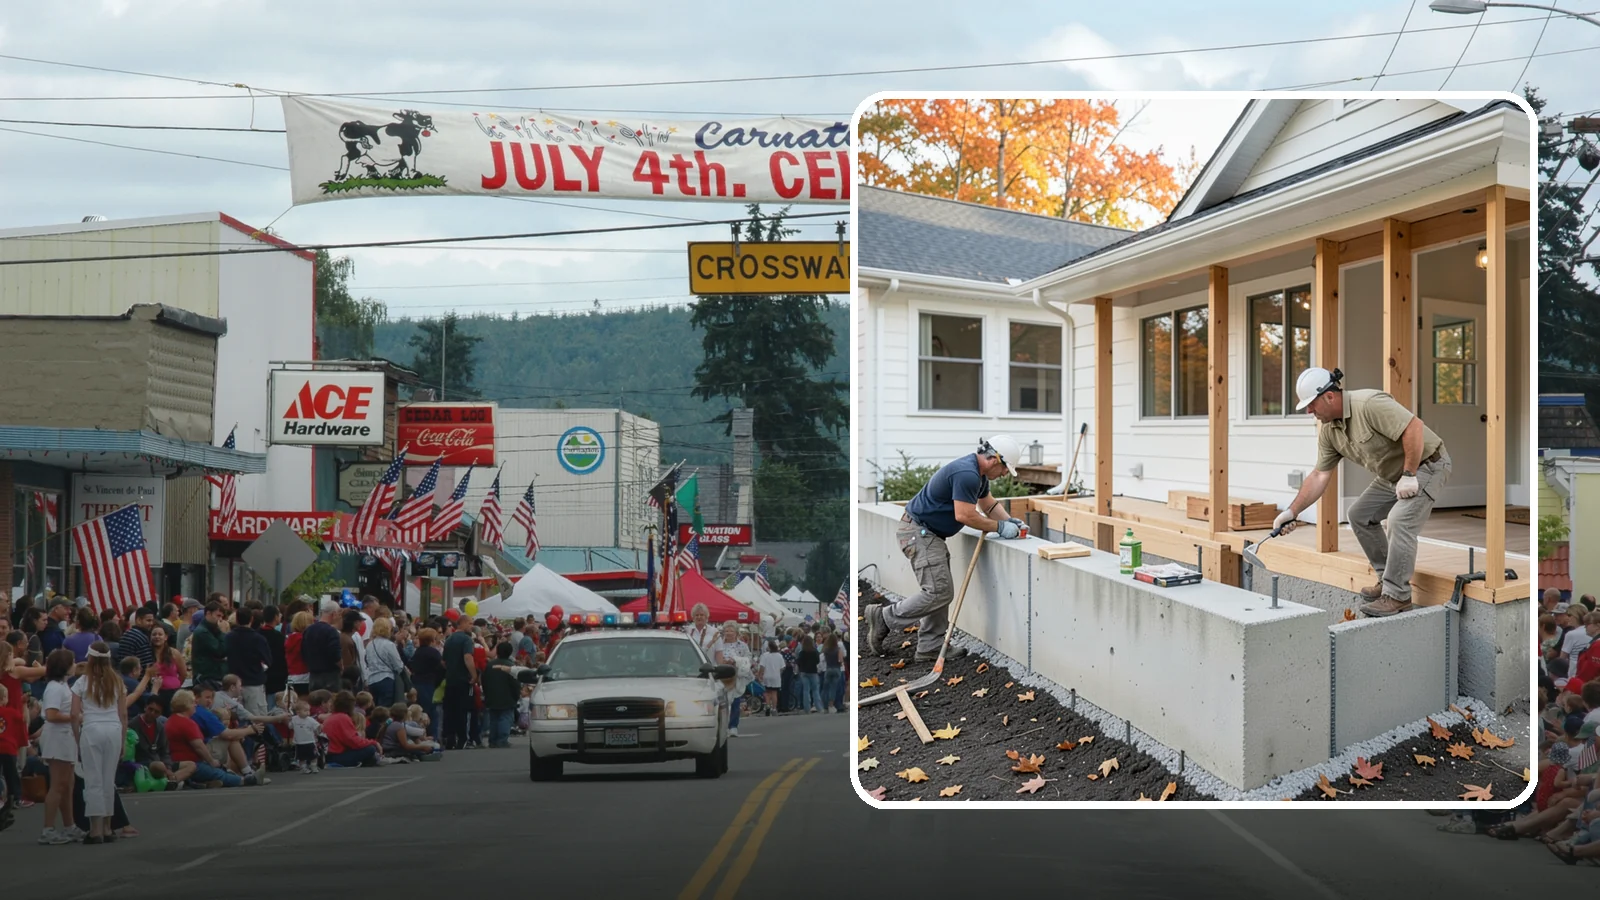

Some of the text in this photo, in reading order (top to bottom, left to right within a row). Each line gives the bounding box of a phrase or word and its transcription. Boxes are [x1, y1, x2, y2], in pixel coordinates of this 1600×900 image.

[695, 121, 850, 150] Carnat
[481, 141, 605, 192] JULY
[632, 150, 746, 197] 4th.
[697, 254, 850, 279] CROSSWA
[283, 380, 373, 420] ACE
[405, 409, 453, 422] CEDAR
[283, 421, 370, 436] Hardware
[416, 428, 476, 447] Coca-Cola
[95, 484, 124, 495] Vincent
[126, 485, 135, 495] de
[137, 486, 155, 495] Paul
[688, 526, 741, 535] CRNATION
[699, 535, 730, 543] GLASS
